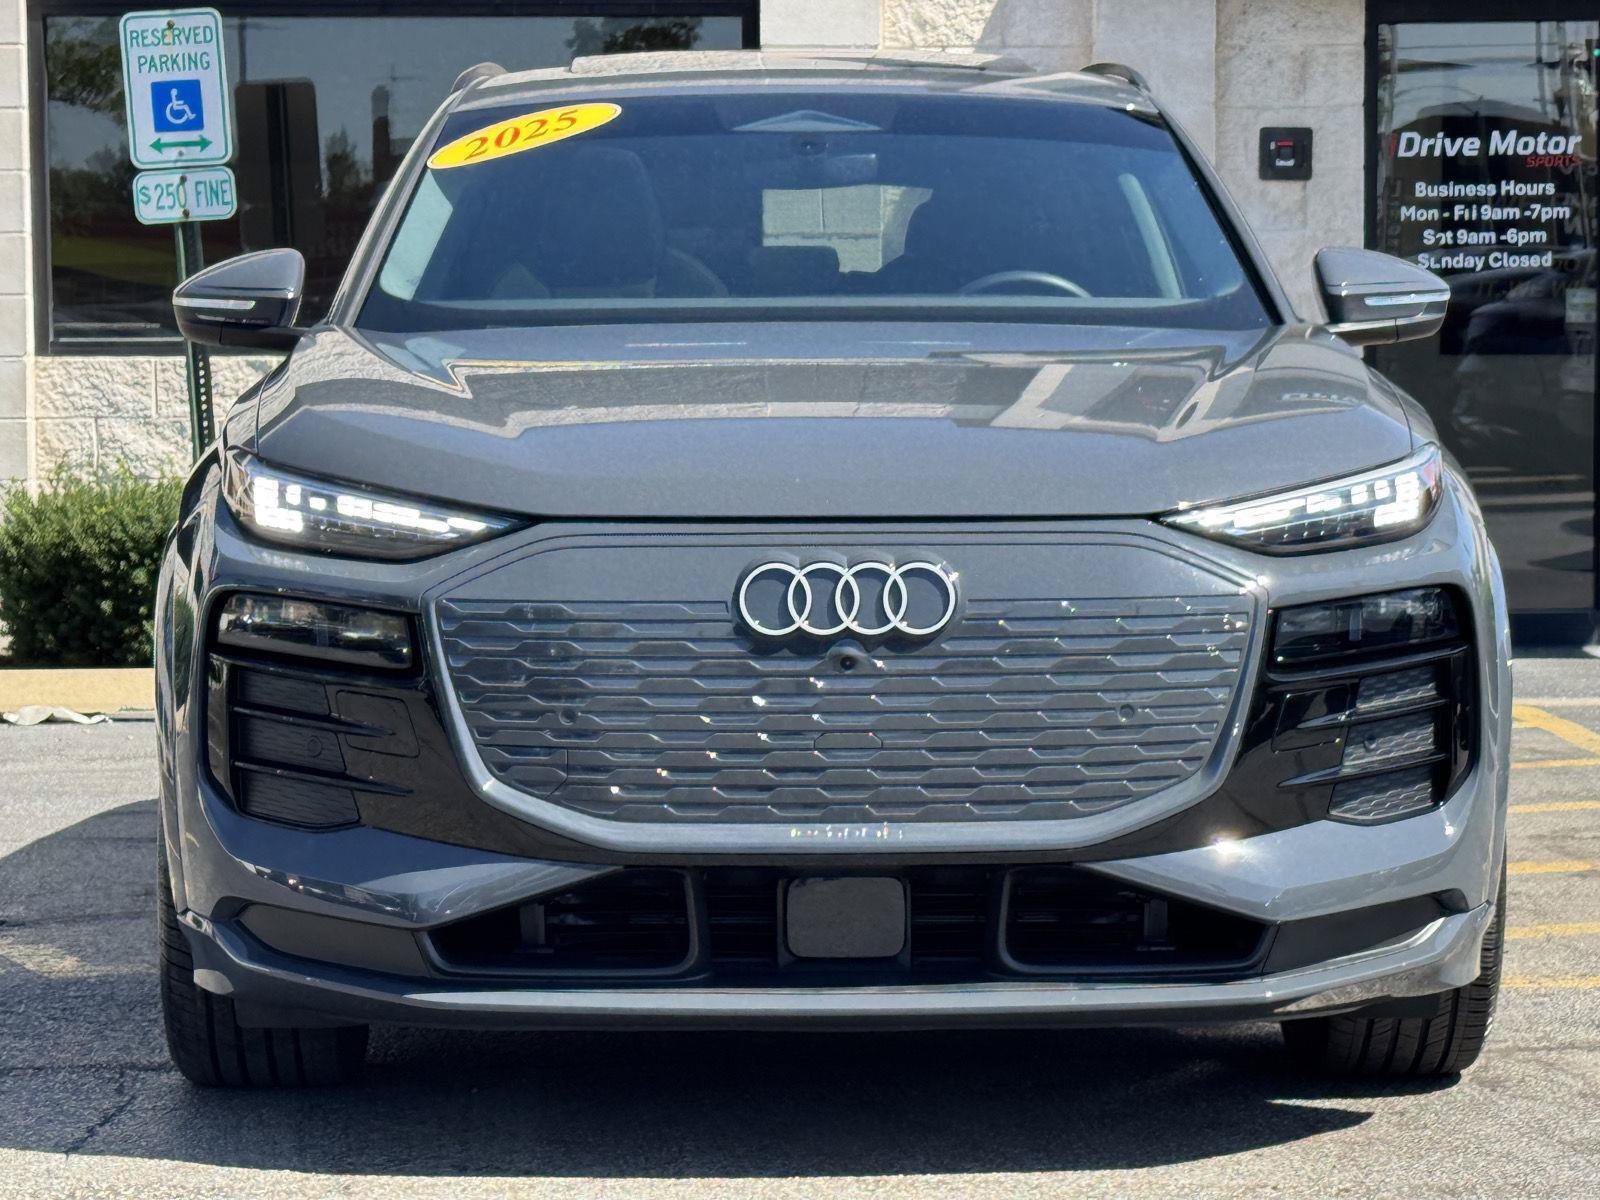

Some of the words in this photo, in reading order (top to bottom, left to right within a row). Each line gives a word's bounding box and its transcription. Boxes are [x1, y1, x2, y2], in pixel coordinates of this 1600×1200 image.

[129, 26, 214, 48] RESERVED
[137, 52, 211, 73] PARKING
[464, 109, 579, 161] 2025
[1488, 129, 1583, 156] Motor
[1525, 155, 1582, 167] SPORTS
[194, 179, 232, 207] FINE
[1414, 181, 1497, 198] Business
[1500, 179, 1556, 196] Hours
[1400, 205, 1439, 222] Mon
[1480, 204, 1521, 220] 9am
[1456, 228, 1497, 244] 9am
[1488, 250, 1553, 268] Closed
